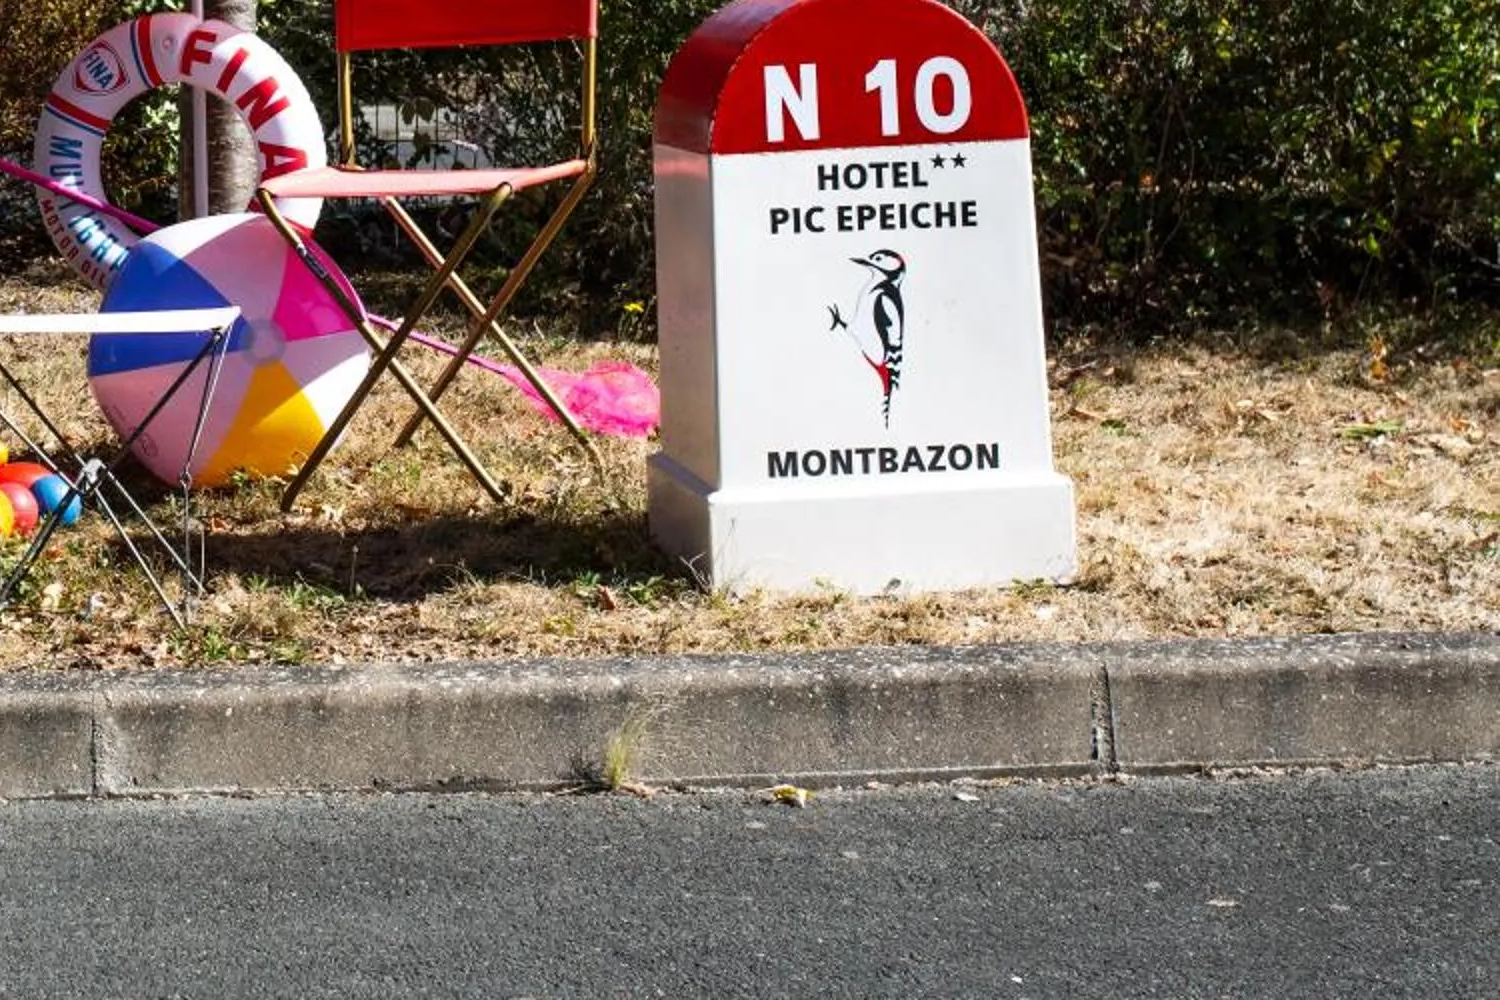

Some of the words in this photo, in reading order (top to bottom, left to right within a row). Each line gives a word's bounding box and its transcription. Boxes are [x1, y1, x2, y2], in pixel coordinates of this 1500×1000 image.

[83, 50, 114, 89] FINA
[180, 30, 308, 182] FINA
[763, 63, 821, 143] N
[865, 56, 973, 138] 10
[817, 161, 929, 191] HOTEL
[41, 199, 79, 261] MOTOR
[769, 203, 825, 235] PIC
[837, 200, 979, 232] EPEICHE
[767, 443, 1000, 478] MONTBAZON
